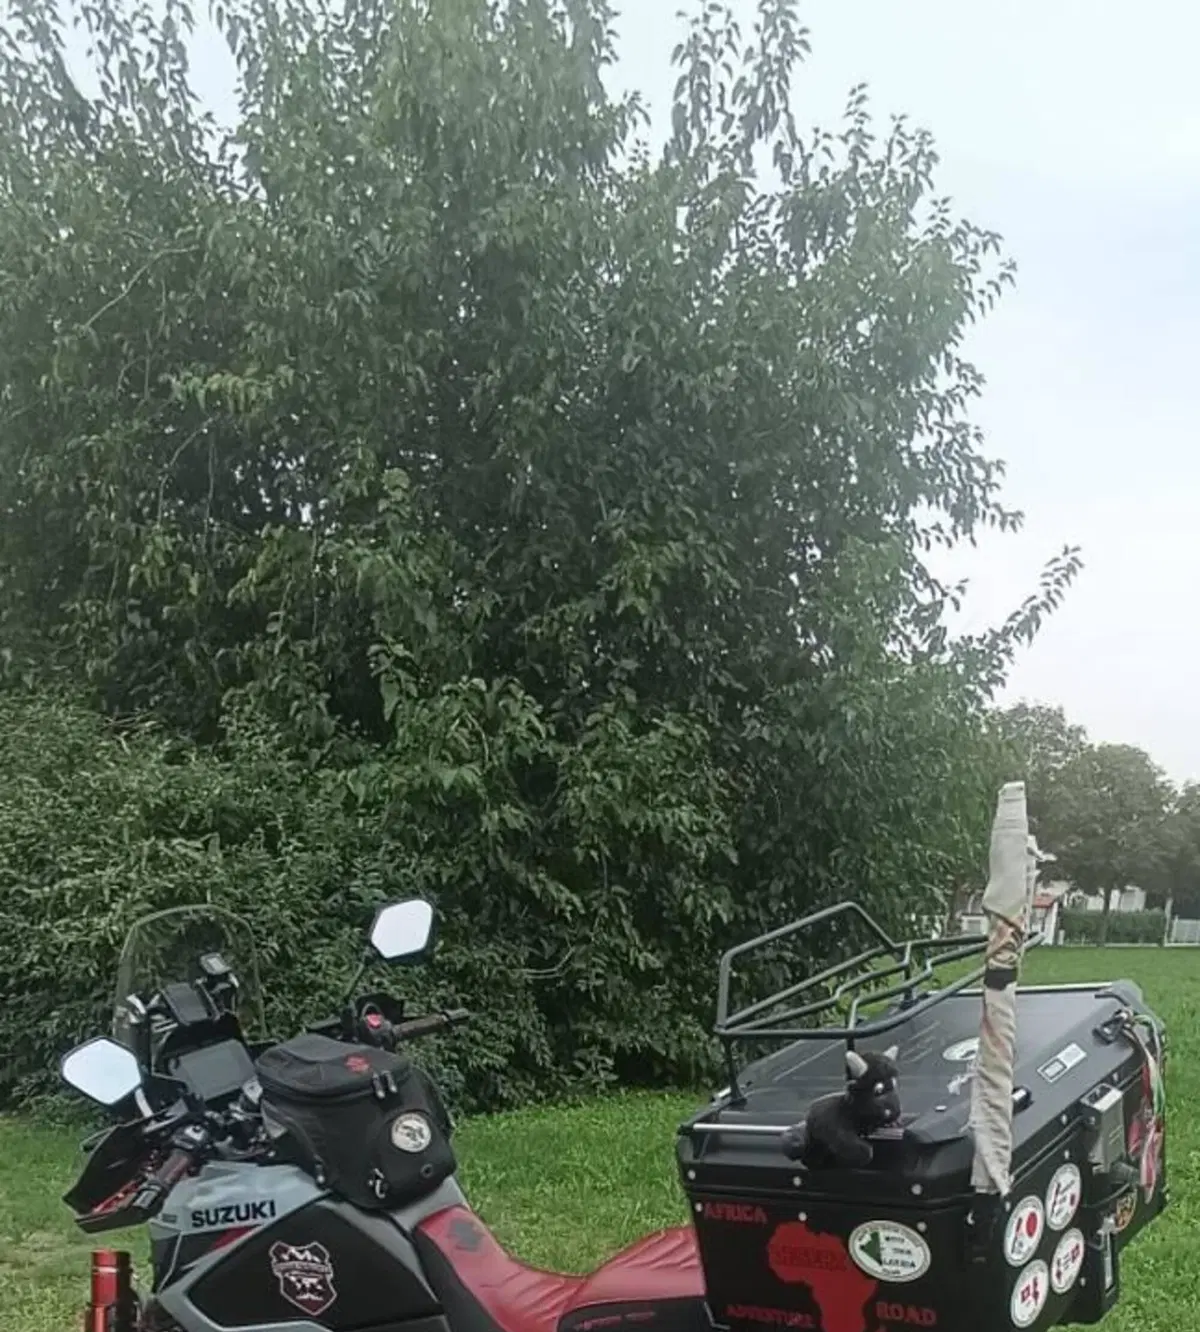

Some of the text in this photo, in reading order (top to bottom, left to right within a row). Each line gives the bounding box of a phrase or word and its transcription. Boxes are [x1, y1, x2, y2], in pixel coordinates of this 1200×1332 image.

[191, 1199, 276, 1228] SUZUKI
[703, 1201, 769, 1225] AFRICA
[876, 1301, 937, 1326] ROAD
